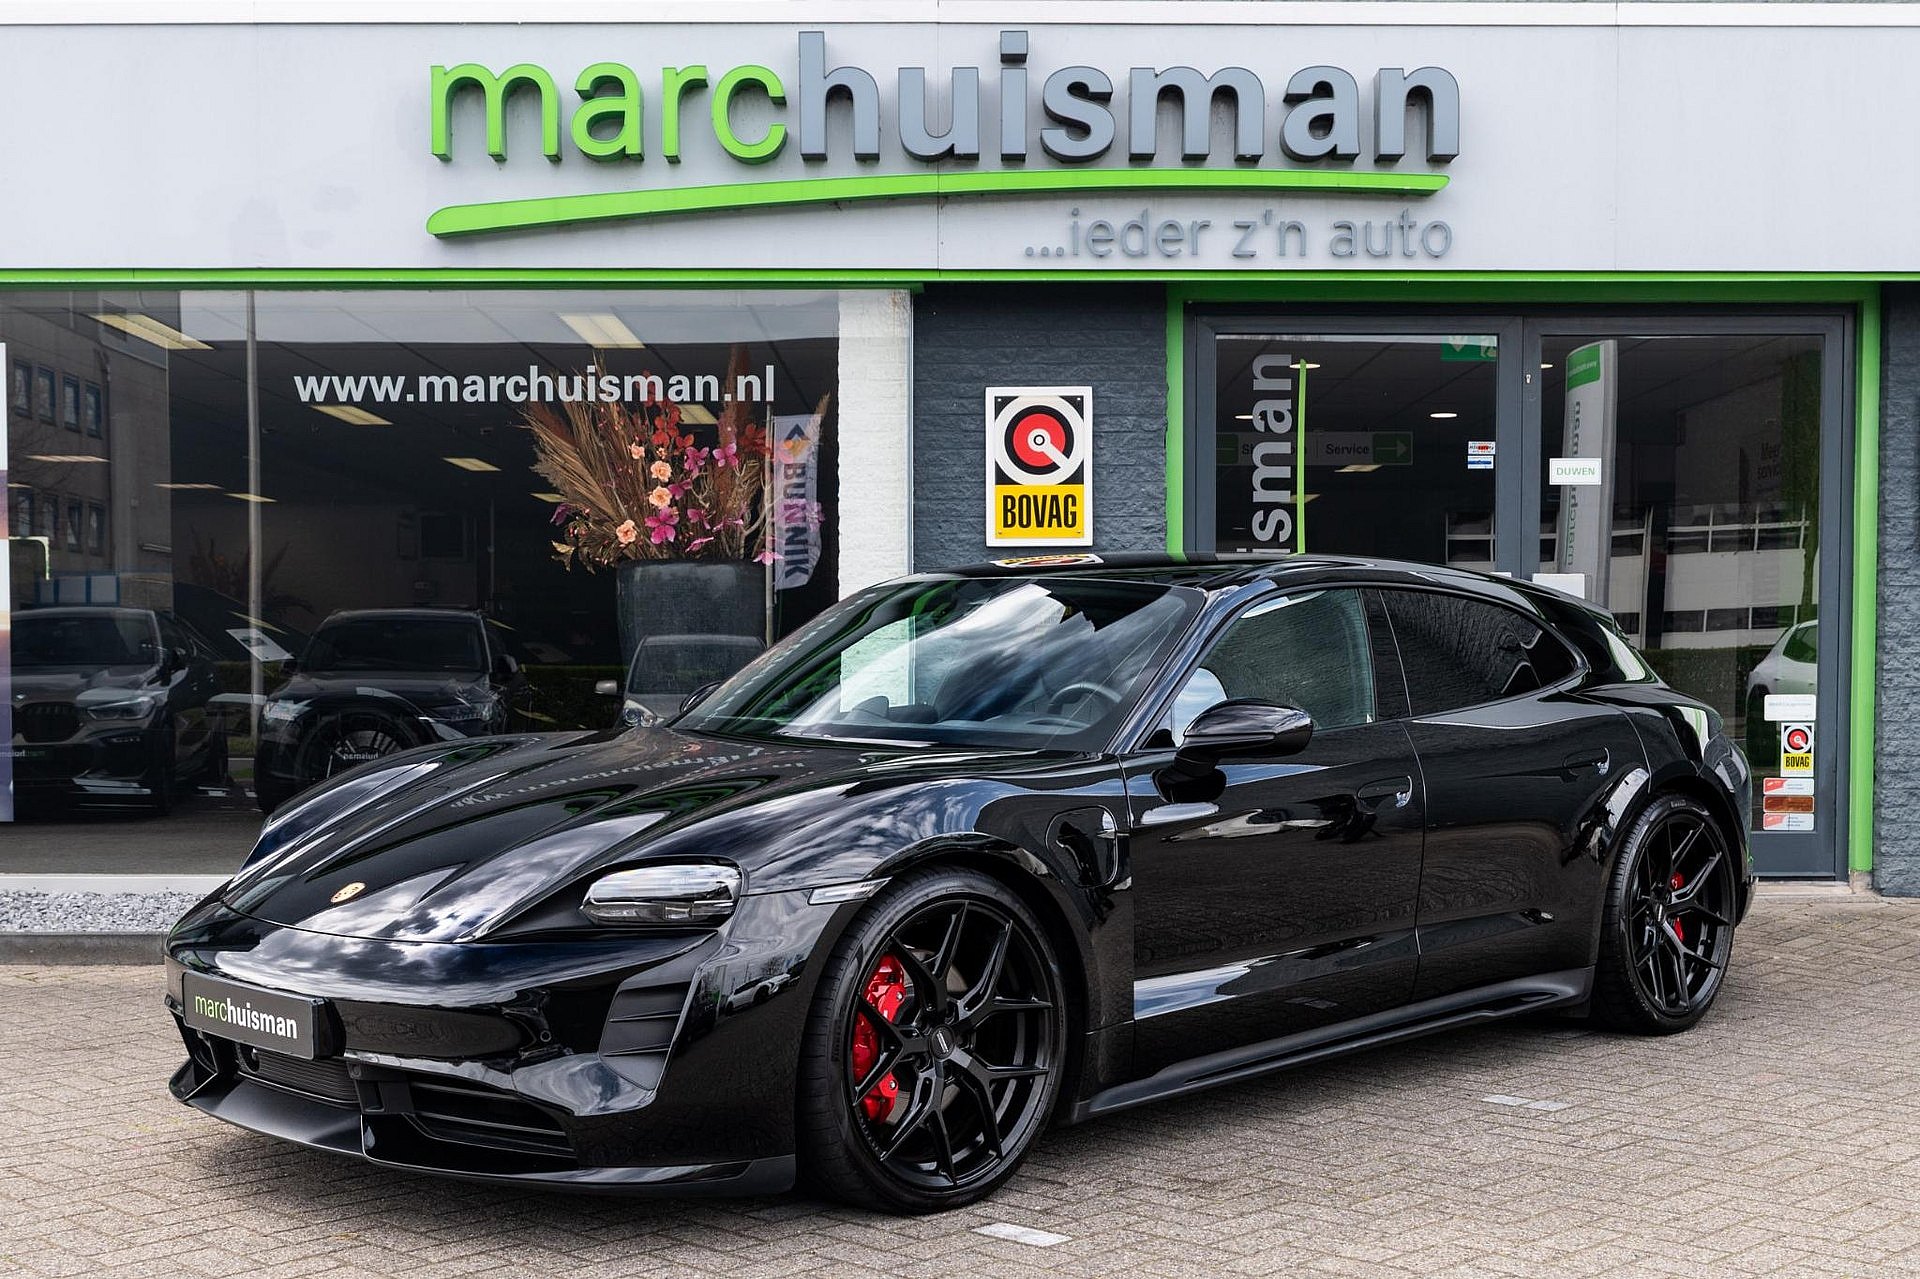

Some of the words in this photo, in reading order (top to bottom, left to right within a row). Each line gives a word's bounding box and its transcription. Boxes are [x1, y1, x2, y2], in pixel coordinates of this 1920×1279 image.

[430, 30, 1461, 165] marchuisman
[1024, 207, 1211, 258] ...ieder
[1232, 208, 1307, 258] z'n
[1330, 207, 1453, 258] auto
[293, 364, 775, 403] www.marchuisman.nl
[1326, 443, 1370, 455] Service
[1555, 466, 1596, 476] DUWEN
[1002, 493, 1077, 529] BOVAG
[1785, 756, 1810, 768] BOVAG
[194, 995, 298, 1039] marchuisman
